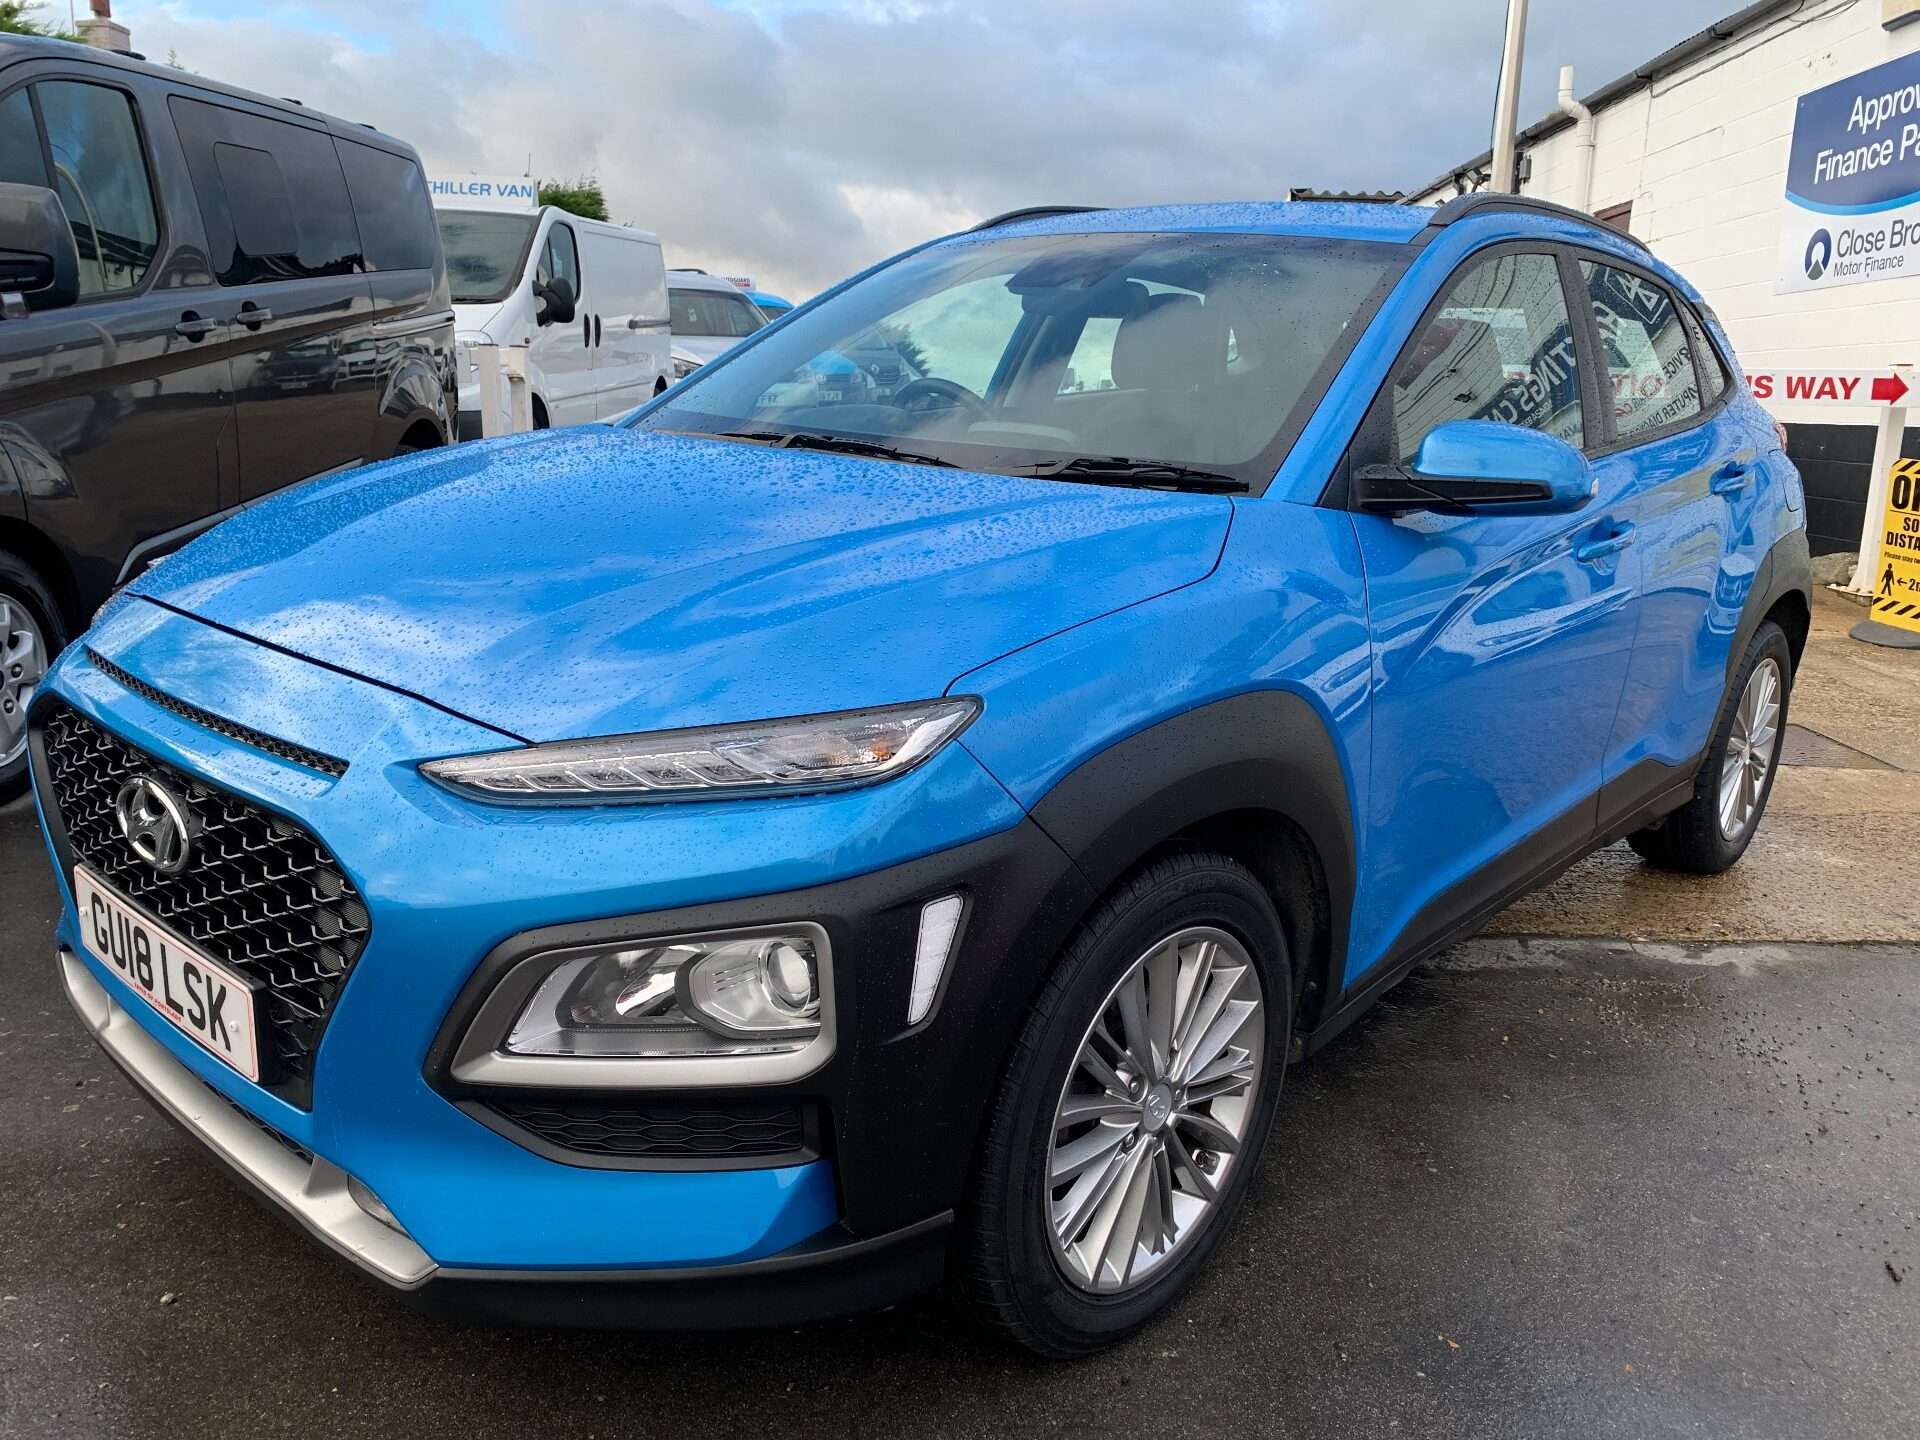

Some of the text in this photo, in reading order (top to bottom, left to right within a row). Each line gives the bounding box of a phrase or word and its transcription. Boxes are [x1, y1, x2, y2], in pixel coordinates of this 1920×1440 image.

[1813, 138, 1894, 185] Finance
[427, 181, 533, 198] HILLER VAN
[1836, 218, 1920, 259] Close Bro
[1833, 254, 1904, 279] Motor Finance
[1786, 376, 1861, 400] WAY
[90, 891, 232, 1052] GU18 LSK
